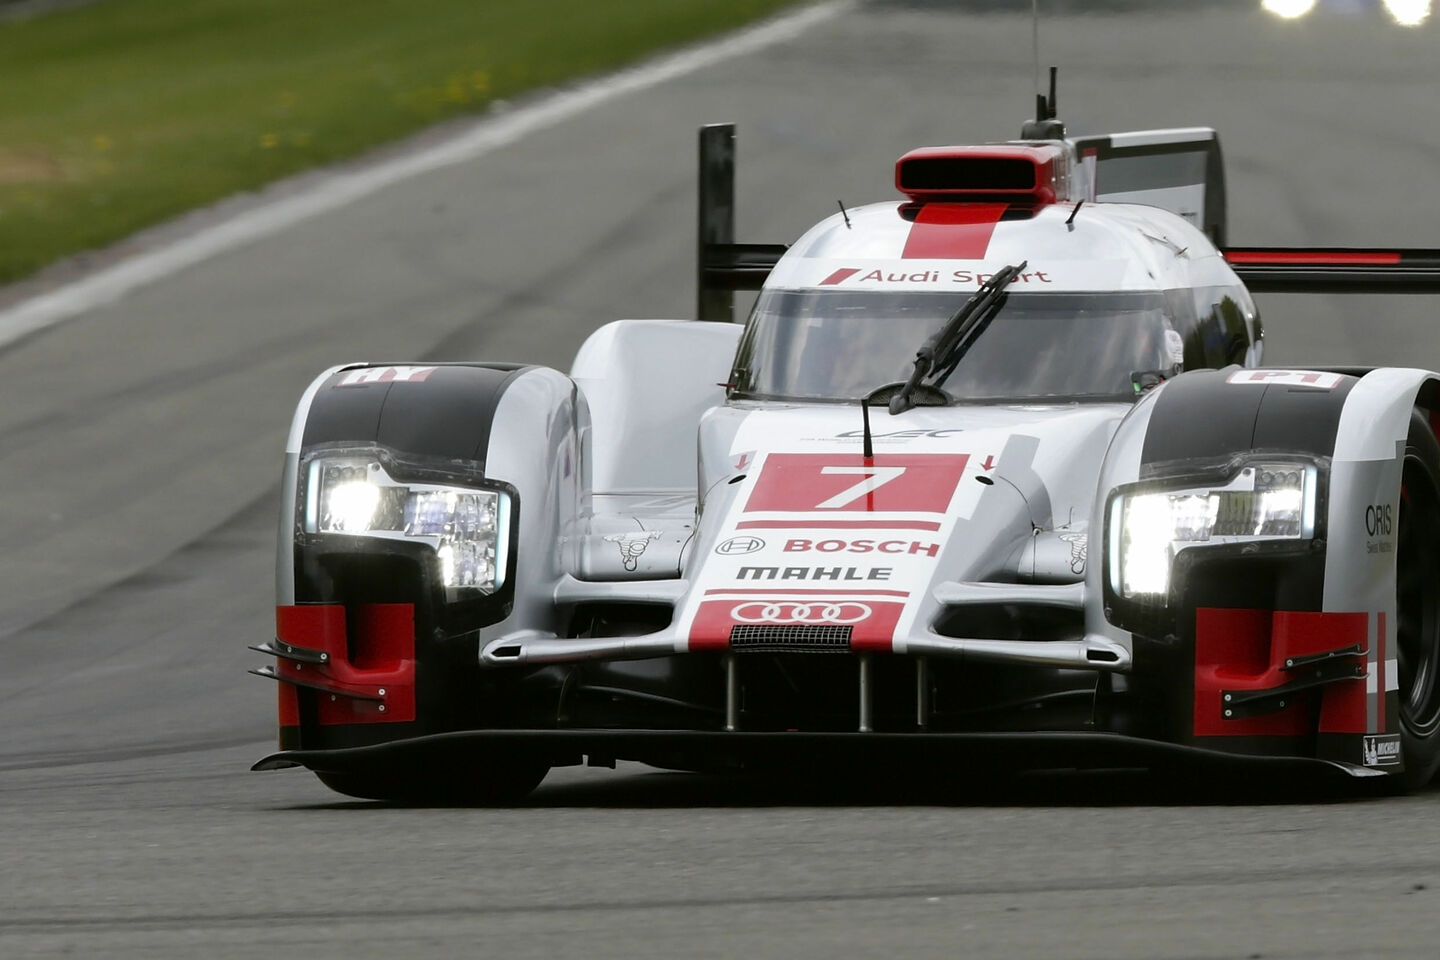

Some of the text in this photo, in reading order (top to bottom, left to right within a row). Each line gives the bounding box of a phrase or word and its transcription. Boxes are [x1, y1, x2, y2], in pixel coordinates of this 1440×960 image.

[859, 269, 939, 282] Audi
[1249, 371, 1322, 383] P1
[815, 466, 907, 508] 7
[1366, 504, 1391, 536] ORIS
[783, 539, 941, 557] BOSCH
[736, 566, 893, 580] MAHLE
